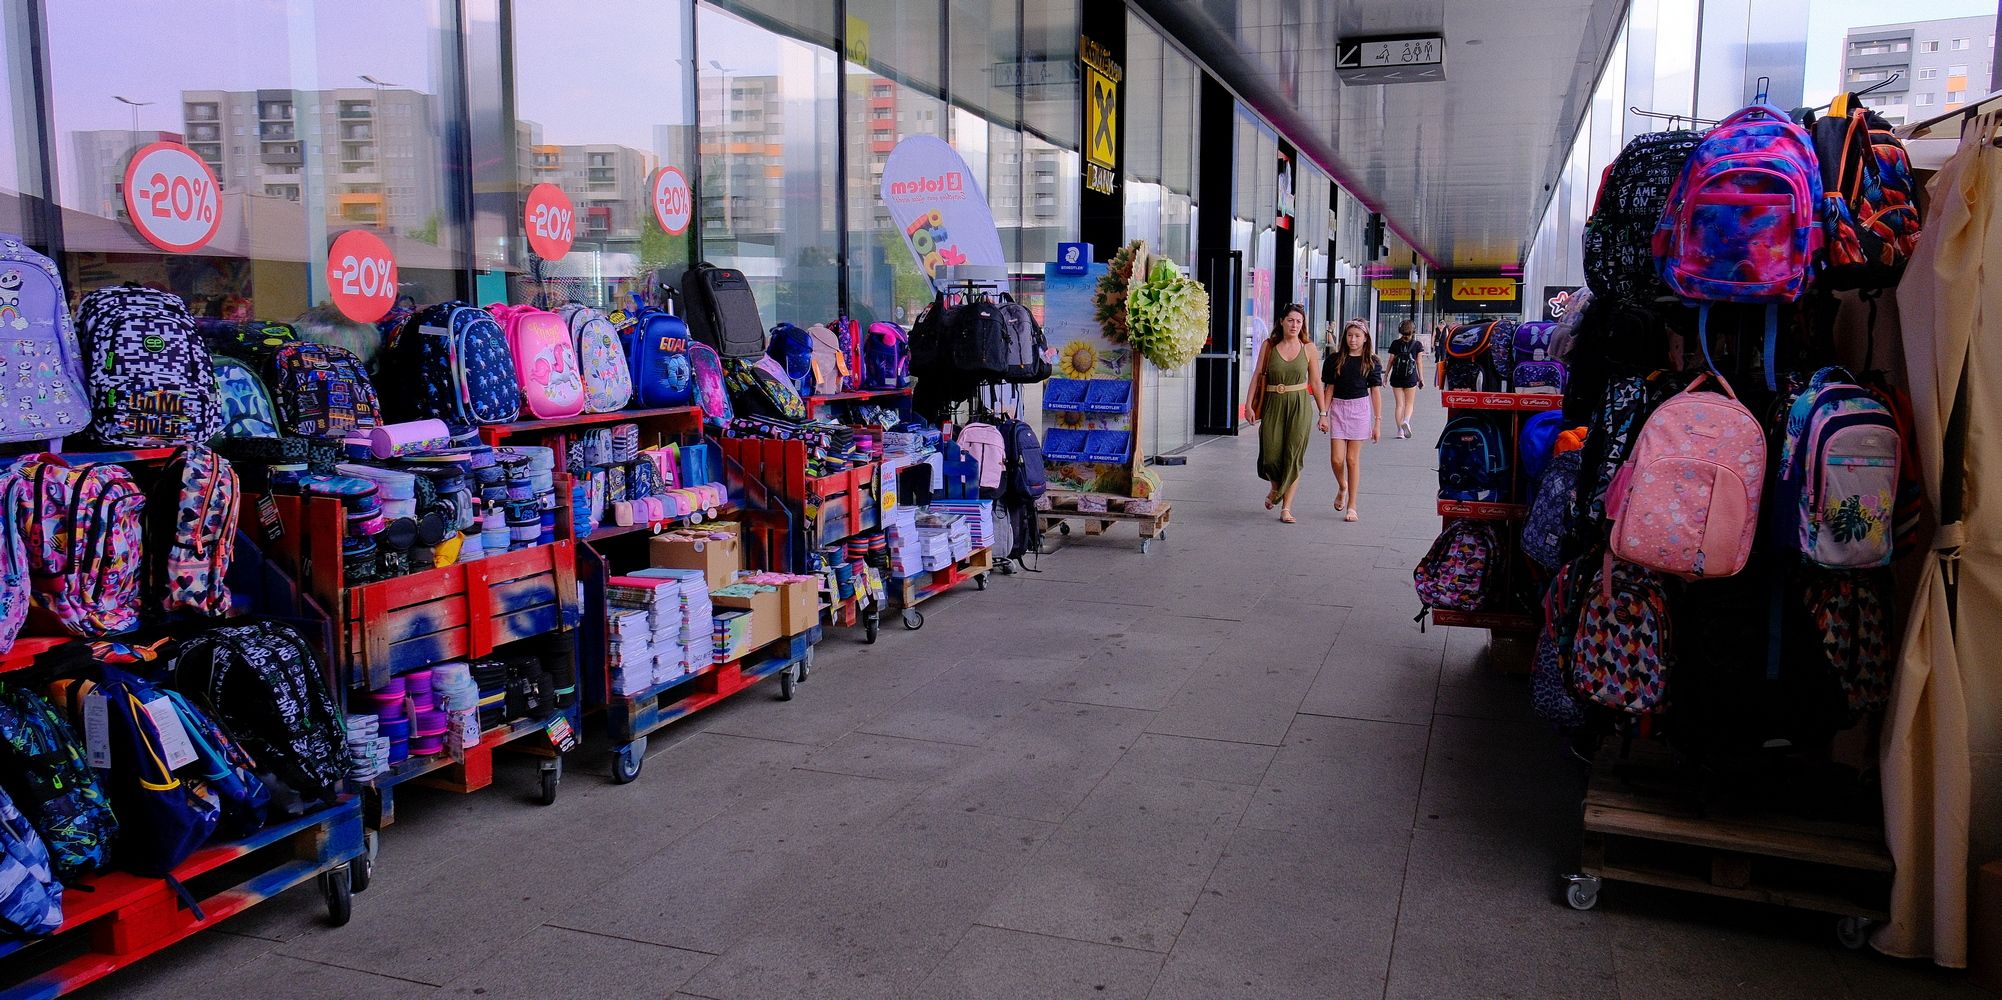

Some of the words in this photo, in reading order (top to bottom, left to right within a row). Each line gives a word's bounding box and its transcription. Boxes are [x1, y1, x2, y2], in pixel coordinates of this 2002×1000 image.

[1087, 163, 1115, 195] BANK
[139, 172, 212, 224] -20%
[660, 186, 688, 216] -20%
[529, 203, 571, 243] -20%
[333, 255, 394, 298] -20%
[659, 337, 687, 352] GOAL
